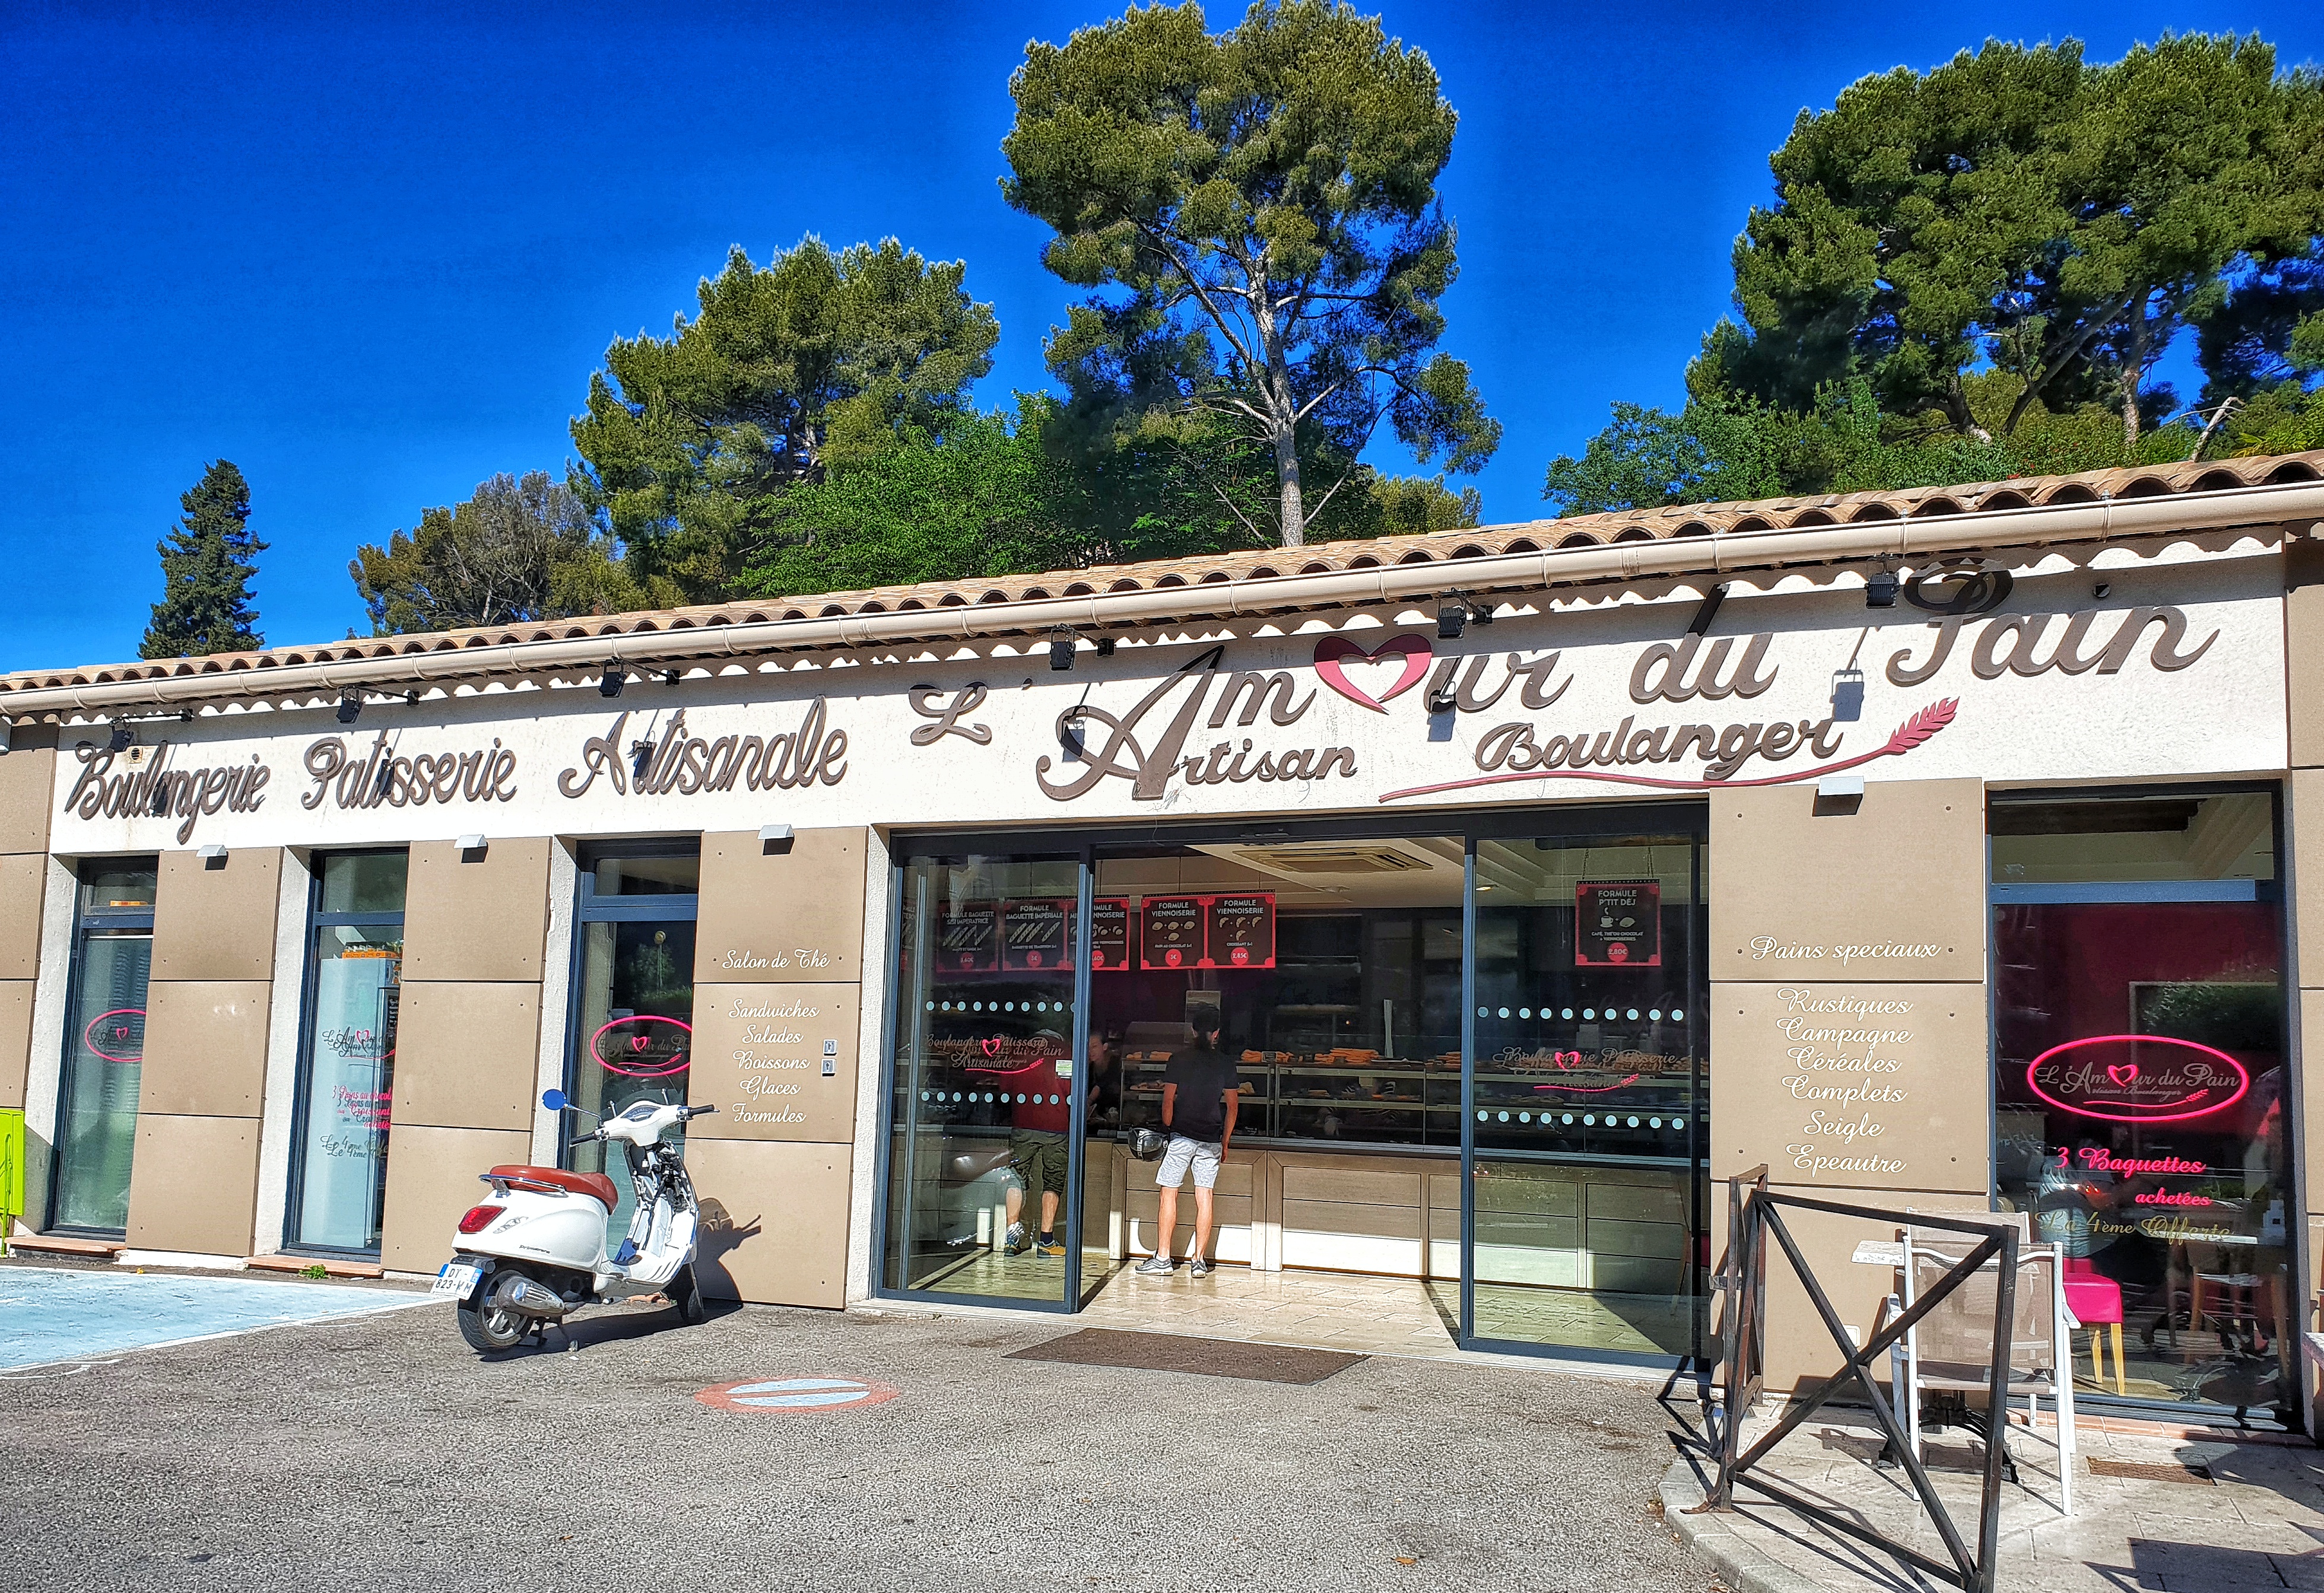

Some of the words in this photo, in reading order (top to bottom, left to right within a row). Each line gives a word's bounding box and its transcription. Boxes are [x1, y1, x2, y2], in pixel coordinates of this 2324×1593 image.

[1628, 584, 1780, 704] du
[1885, 557, 2221, 688] Pain
[1475, 715, 1844, 781] Boulanger
[301, 729, 517, 810] Patisserie
[722, 949, 769, 969] Salon
[771, 950, 790, 968] de
[794, 949, 830, 968] Thé
[1750, 936, 1828, 961] Pains
[1832, 940, 1942, 967] speciaux
[728, 999, 820, 1018] Sandwiches
[1776, 988, 1914, 1022] Rustiques
[742, 1024, 804, 1043] Salades
[1776, 1017, 1915, 1051] Campagne
[732, 1051, 811, 1069] Boissons
[1786, 1046, 1903, 1073] Céréales
[739, 1075, 801, 1101] Glaces
[2158, 1069, 2185, 1086] du
[2183, 1063, 2240, 1088] Pain
[1782, 1074, 1908, 1109] Complets
[2122, 1086, 2182, 1102] Boulanger
[732, 1103, 807, 1123] Formules
[1803, 1110, 1885, 1144] Seigle
[1785, 1144, 1907, 1178] Epeautre
[2055, 1147, 2069, 1169] 3
[2078, 1147, 2206, 1178] Baguettes
[2135, 1187, 2212, 1207] achetées
[2087, 1211, 2136, 1235] 4ème
